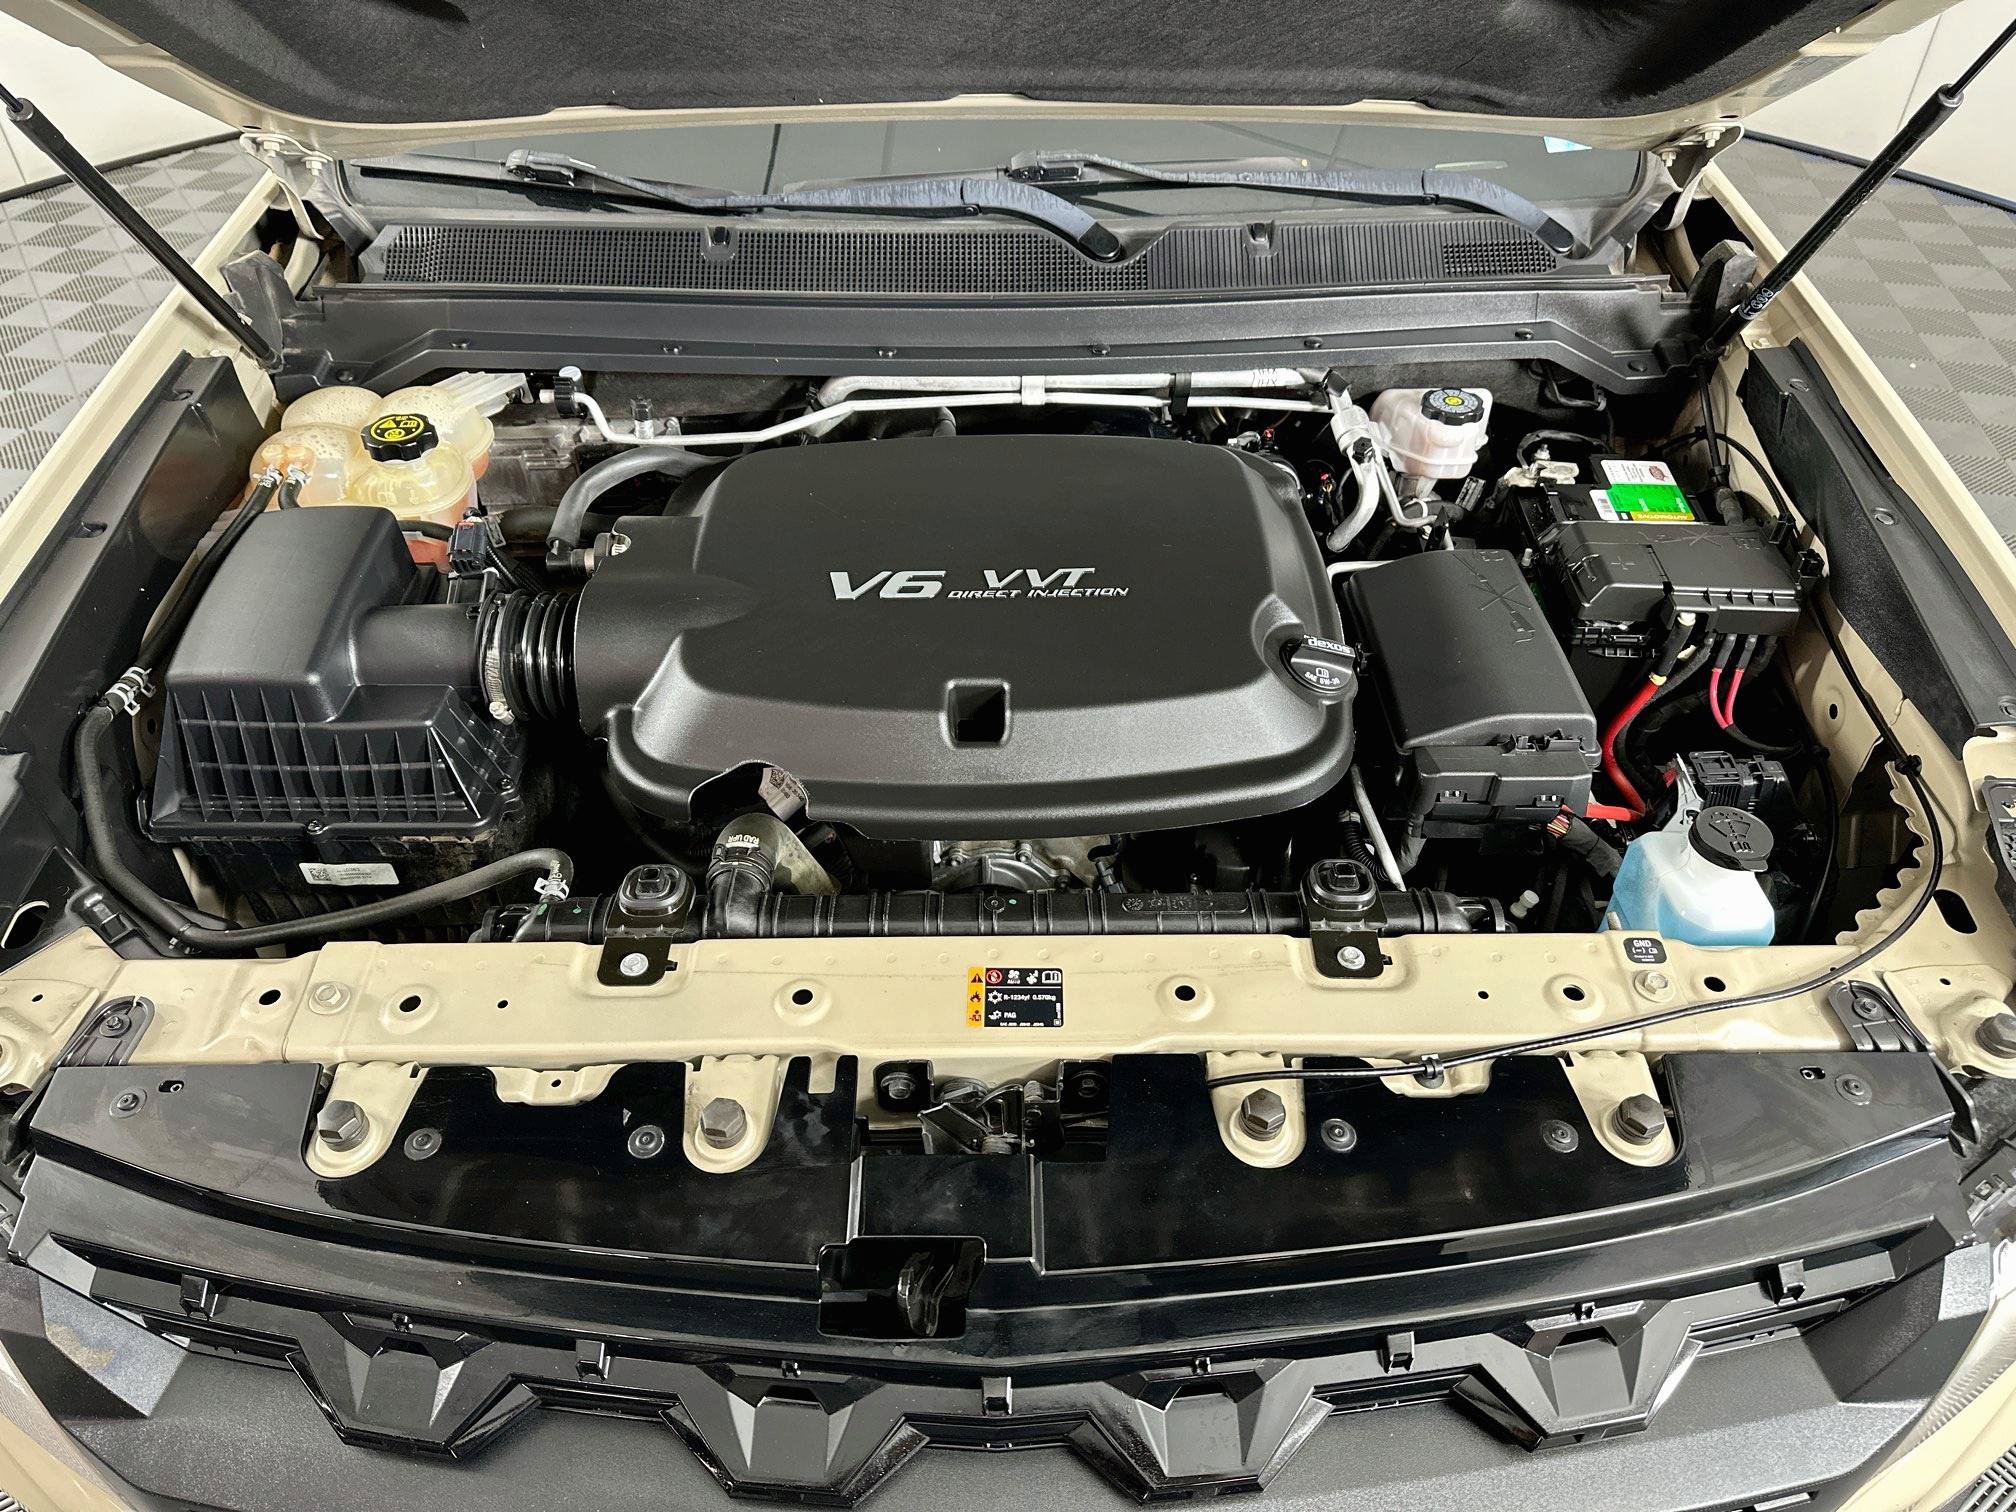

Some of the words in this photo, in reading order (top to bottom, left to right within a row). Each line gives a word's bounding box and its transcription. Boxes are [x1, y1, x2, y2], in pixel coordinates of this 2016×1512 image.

[829, 570, 946, 600] V6
[983, 567, 1095, 588] VVT
[947, 588, 1021, 599] DIRECT
[1027, 586, 1129, 599] INJECTION
[1304, 635, 1351, 654] dexos
[743, 834, 760, 845] RAD
[1633, 939, 1652, 948] GND
